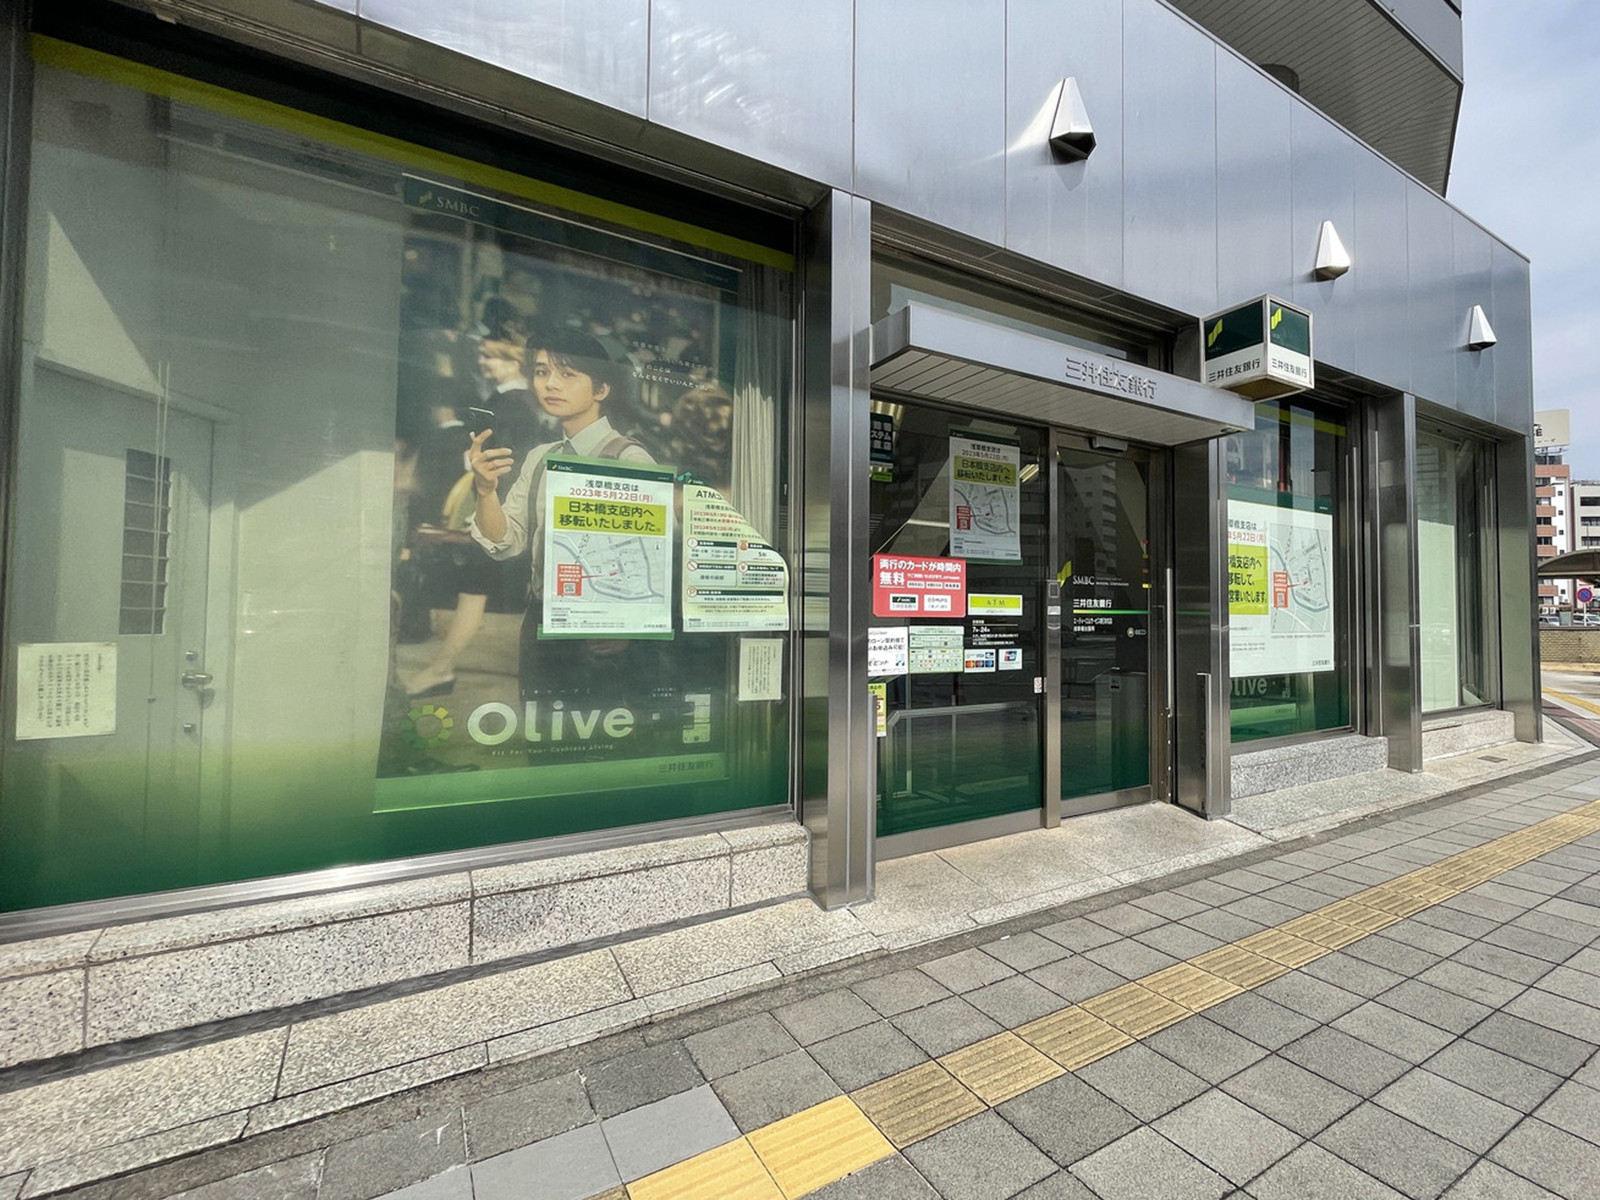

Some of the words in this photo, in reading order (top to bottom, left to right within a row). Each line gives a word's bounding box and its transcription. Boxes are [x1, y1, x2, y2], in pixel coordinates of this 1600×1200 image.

[436, 197, 480, 217] SMBC
[1208, 358, 1260, 383] 三井住友銀行
[1271, 358, 1308, 378] 三井住友銀行
[1065, 357, 1157, 400] 三井住友銀行
[569, 487, 654, 503] 2023年5月22日(月)
[585, 479, 639, 492] 浅草橋支店は
[569, 500, 655, 518] 日本橋支店内へ
[559, 513, 662, 532] 移転いたしました。
[880, 571, 905, 586] 無料
[1073, 599, 1112, 608] 三井住友銀行
[467, 700, 635, 745] Olive
